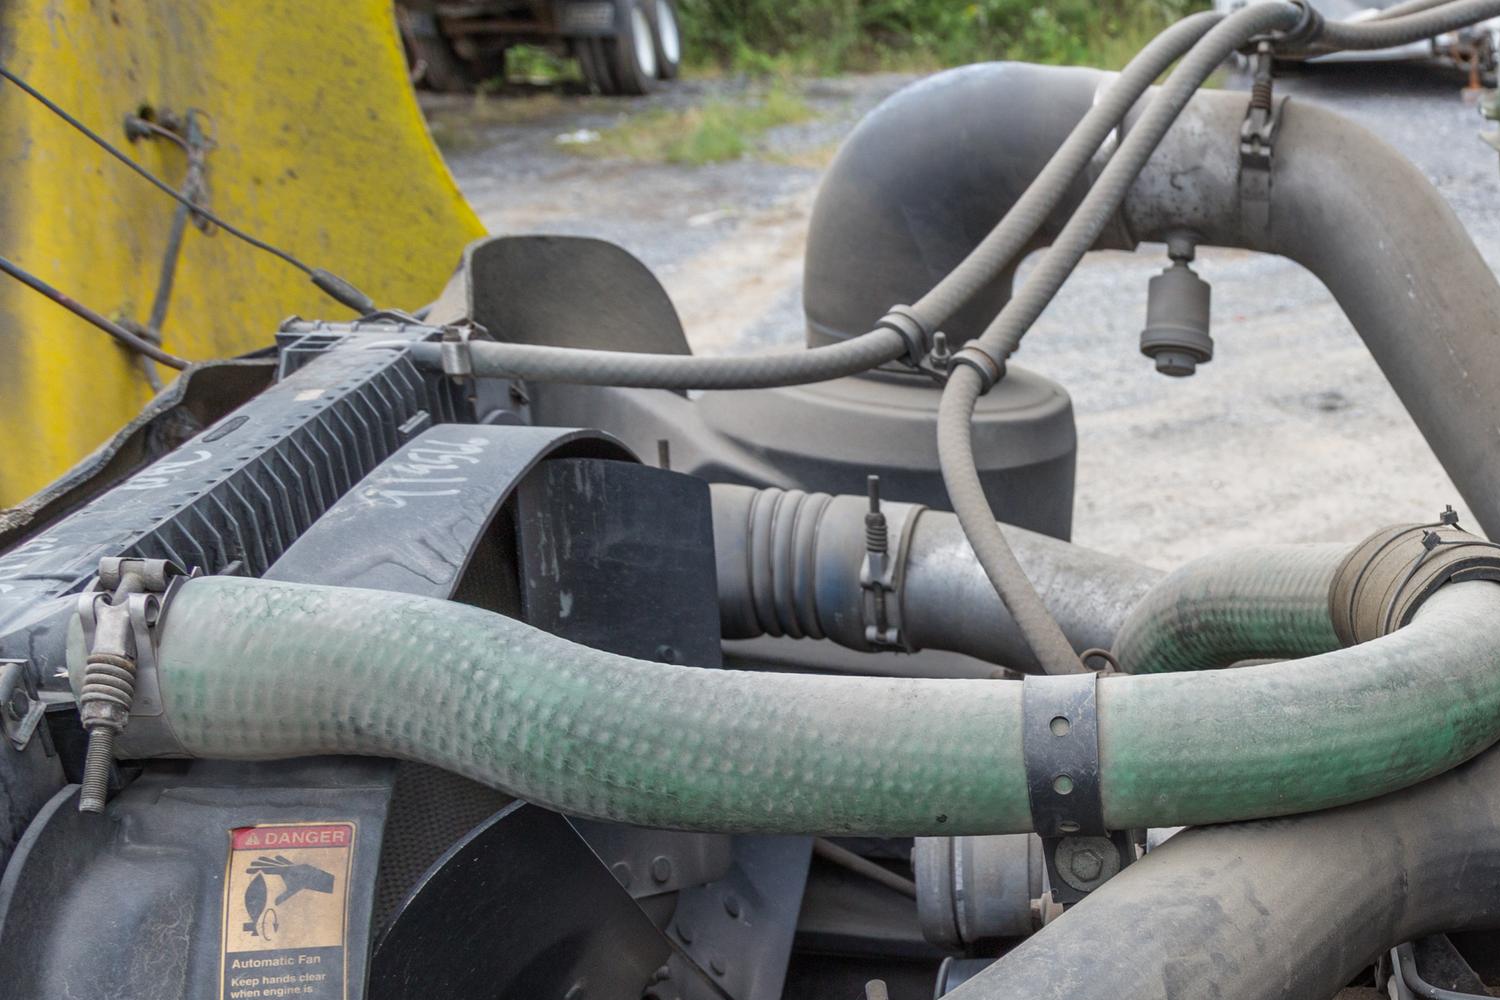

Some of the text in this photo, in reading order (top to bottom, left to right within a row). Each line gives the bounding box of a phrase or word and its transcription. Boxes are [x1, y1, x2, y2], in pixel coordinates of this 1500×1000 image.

[264, 831, 345, 845] DANGER
[232, 955, 321, 969] Automatic Fan
[231, 972, 326, 987] Keep hands clear
[230, 984, 314, 999] when engine is
